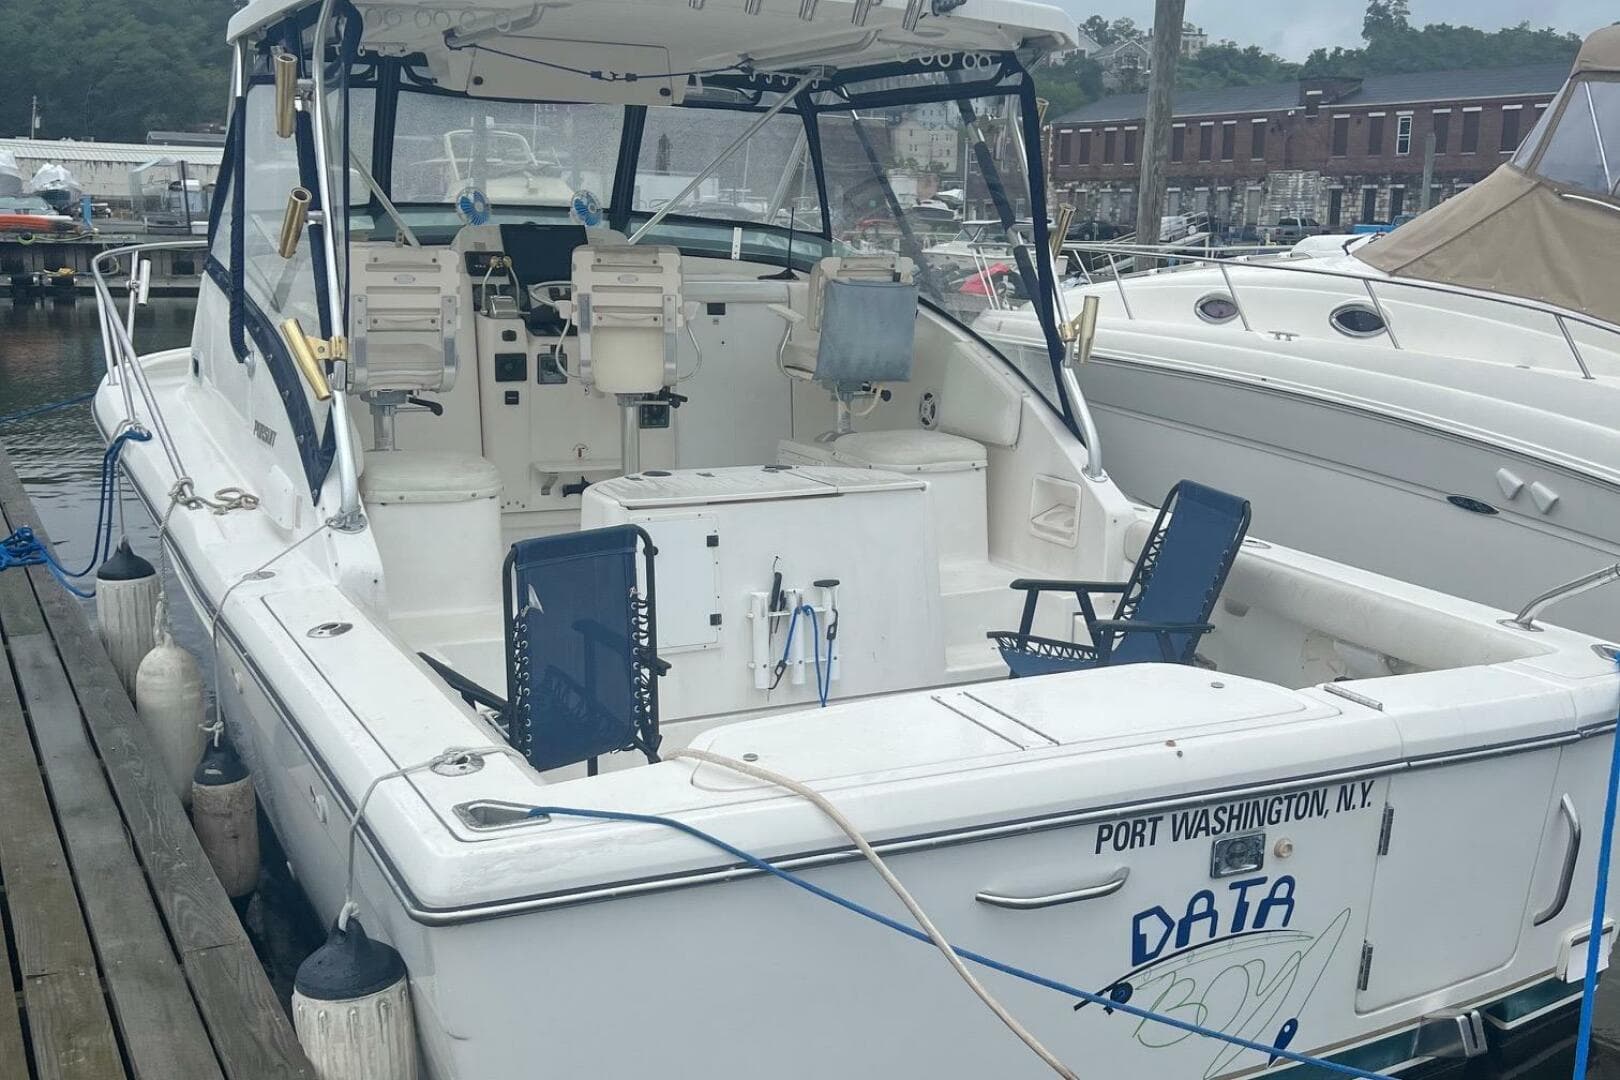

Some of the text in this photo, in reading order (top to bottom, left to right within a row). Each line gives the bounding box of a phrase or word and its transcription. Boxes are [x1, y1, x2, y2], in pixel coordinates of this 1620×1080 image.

[1095, 780, 1374, 854] PORT WASHINGTON, N.Y.
[1132, 875, 1296, 967] DATA
